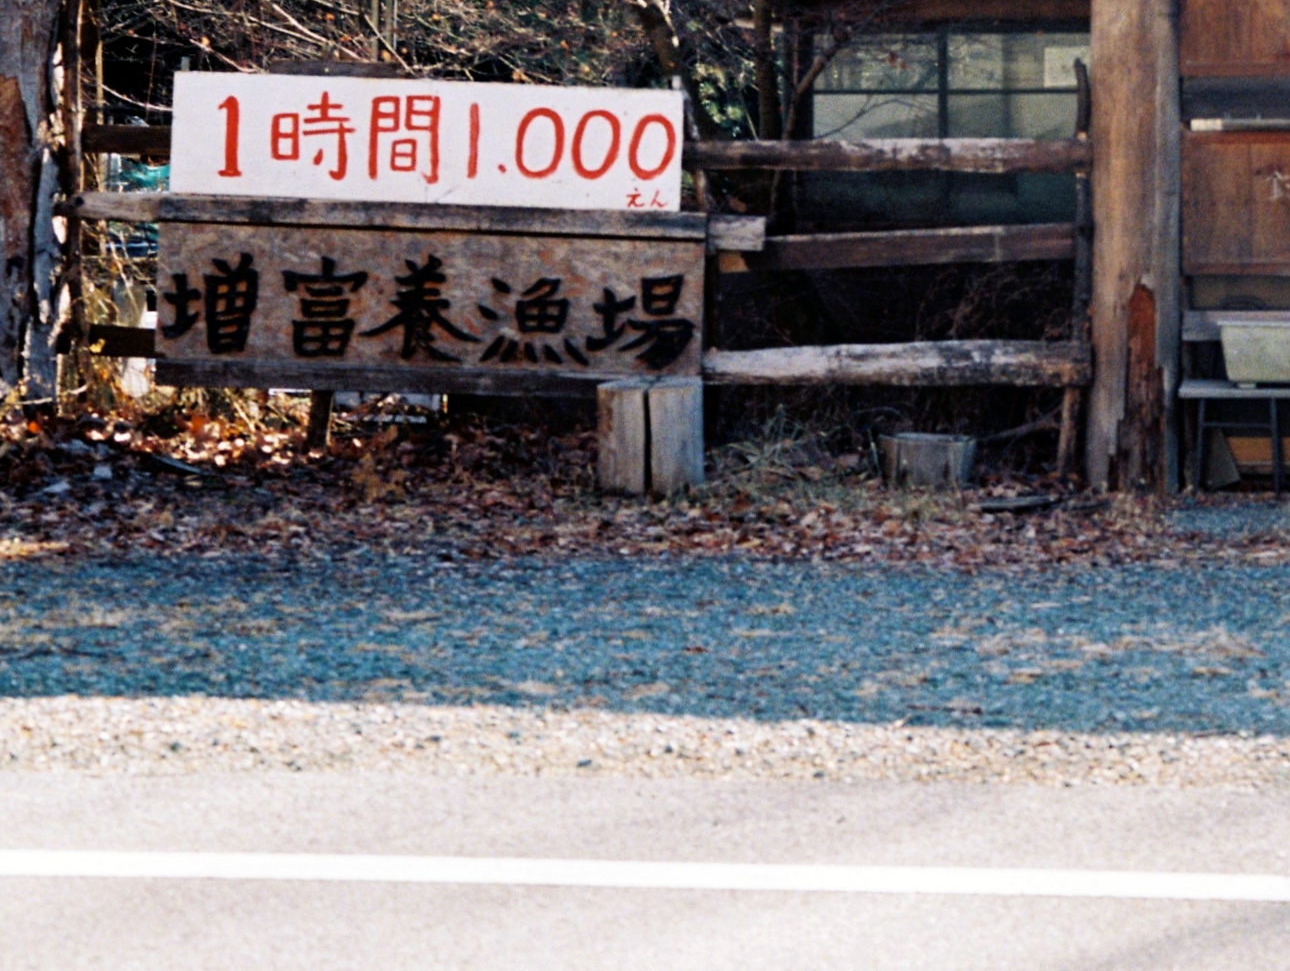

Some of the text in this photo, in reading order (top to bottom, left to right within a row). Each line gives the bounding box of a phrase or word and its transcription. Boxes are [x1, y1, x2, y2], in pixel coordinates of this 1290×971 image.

[161, 251, 697, 372] 増富養漁場
